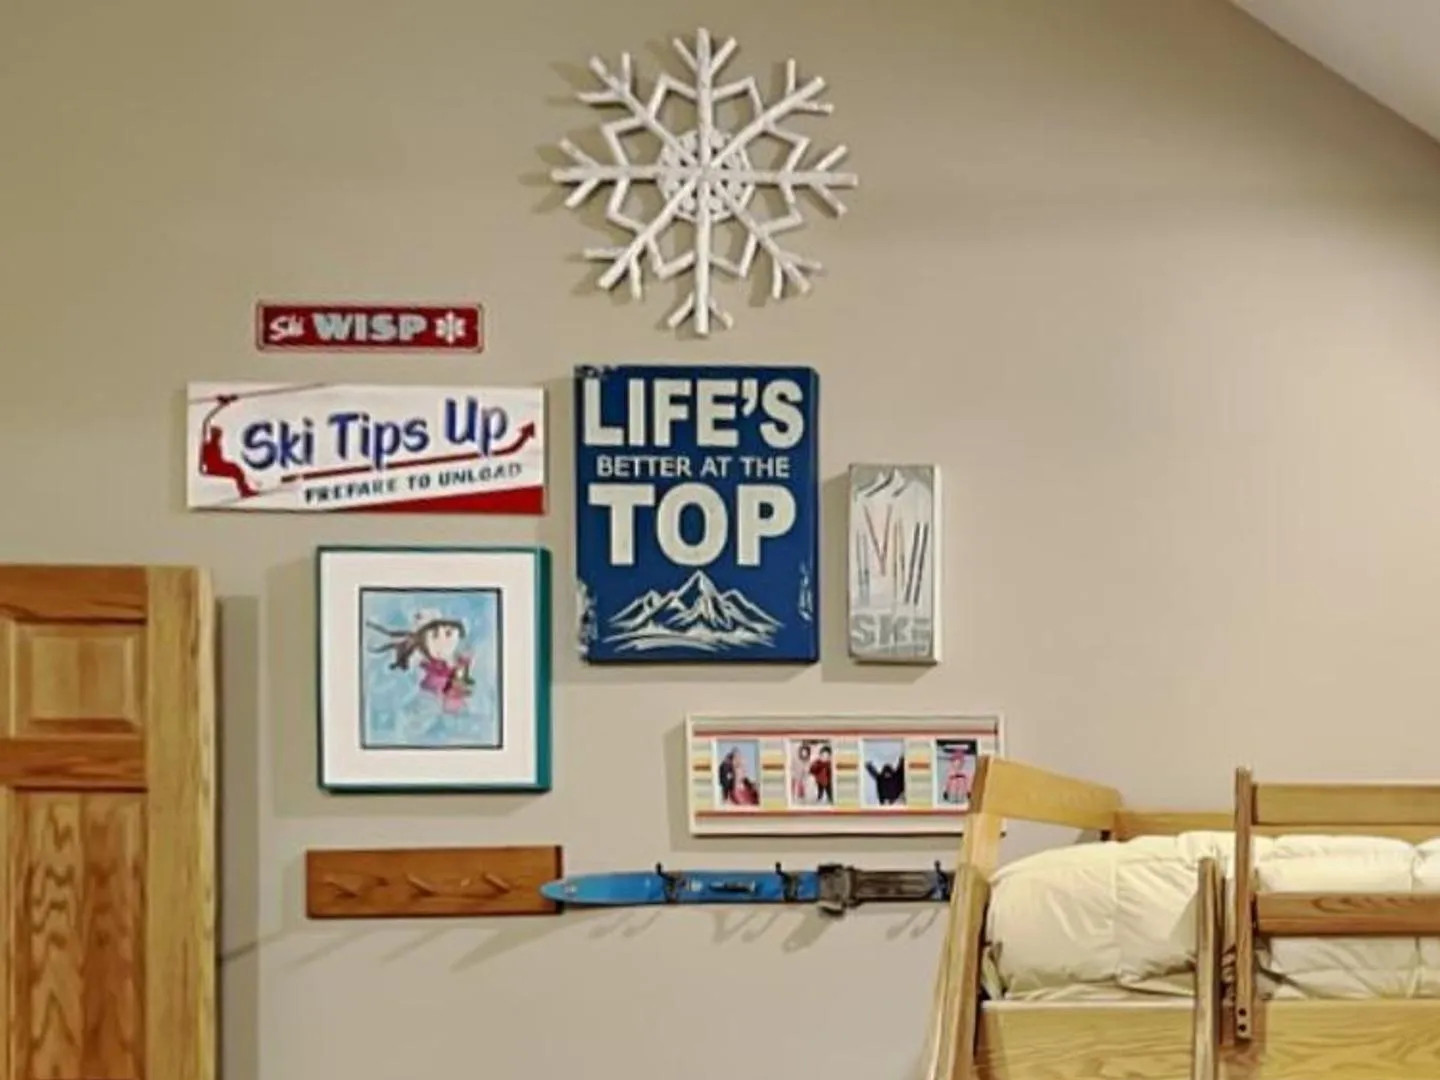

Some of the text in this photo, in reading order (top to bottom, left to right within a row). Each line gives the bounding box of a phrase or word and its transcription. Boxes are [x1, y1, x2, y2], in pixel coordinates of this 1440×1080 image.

[312, 313, 428, 341] WISP
[241, 397, 508, 471] Ski Tips Up
[583, 378, 804, 449] LIFE'S
[305, 462, 522, 504] PREPARE TO UNLOAD
[596, 455, 791, 479] BETTER AT THE
[587, 482, 797, 567] TOP
